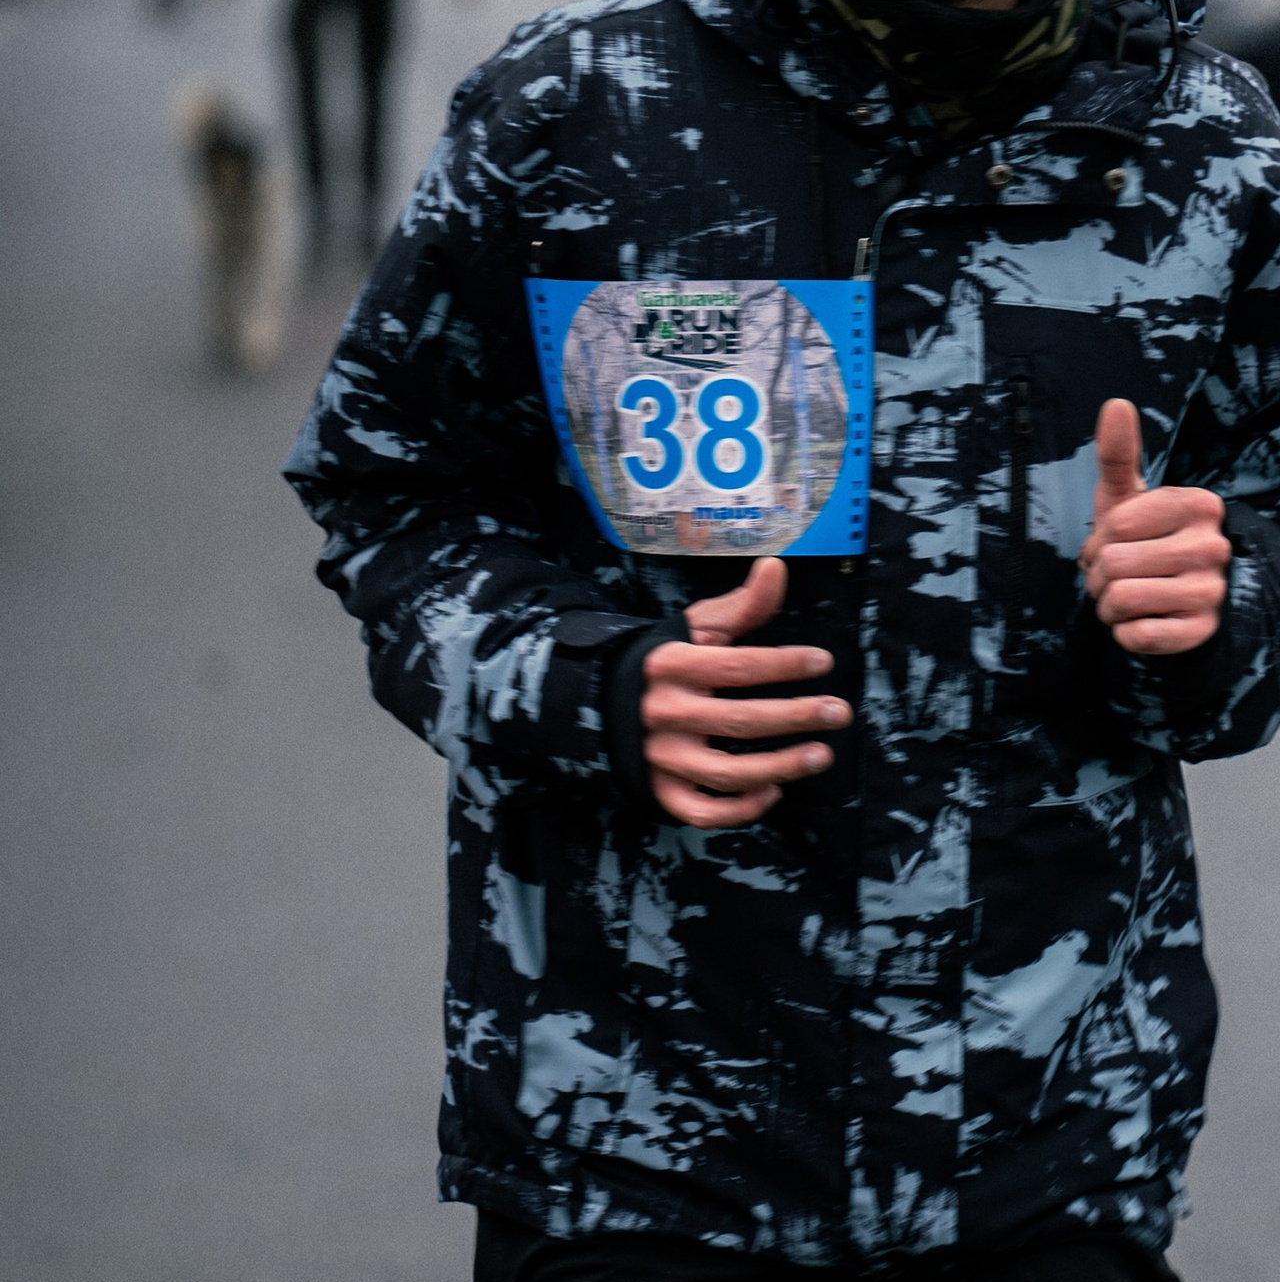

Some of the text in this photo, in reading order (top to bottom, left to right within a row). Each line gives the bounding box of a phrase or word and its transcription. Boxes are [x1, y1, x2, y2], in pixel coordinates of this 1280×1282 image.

[669, 309, 741, 332] RUN
[662, 333, 741, 355] RIDE
[619, 377, 764, 491] 38
